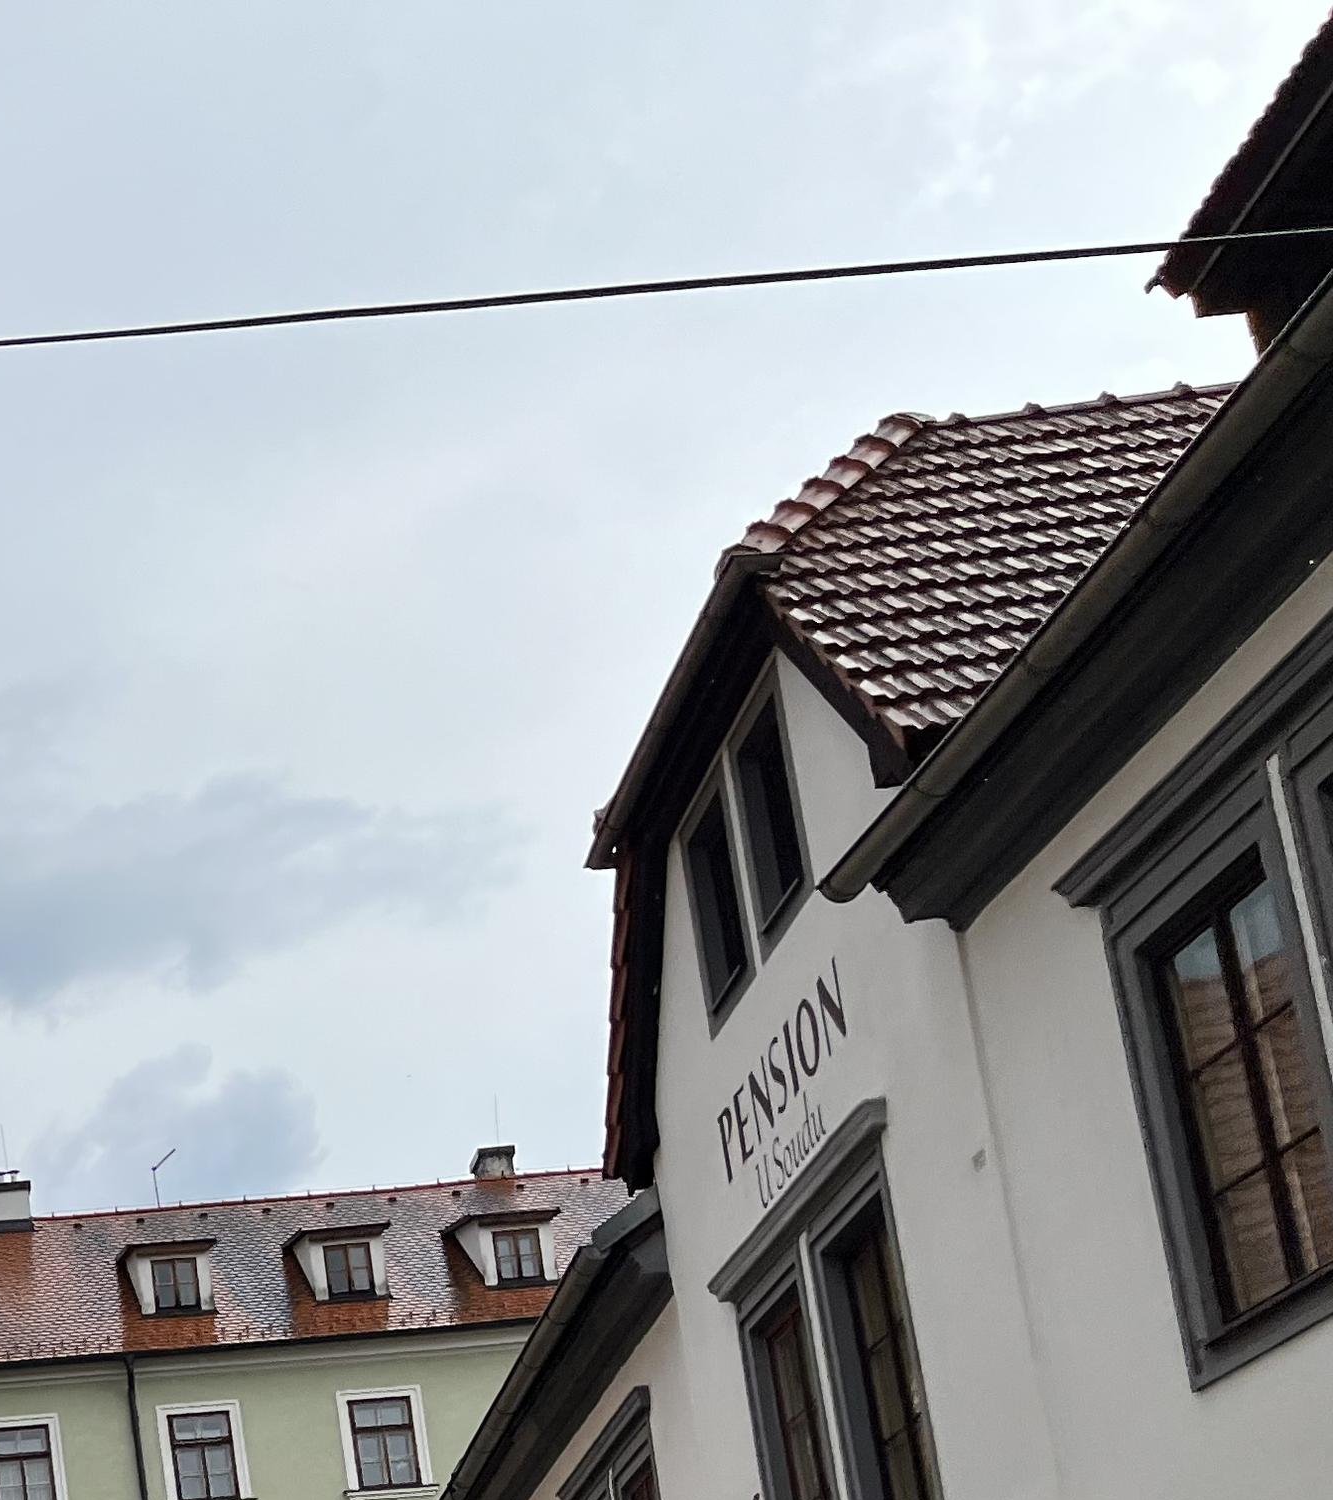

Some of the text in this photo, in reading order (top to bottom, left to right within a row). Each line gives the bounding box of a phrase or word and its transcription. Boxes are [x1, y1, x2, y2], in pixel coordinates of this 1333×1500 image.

[717, 955, 847, 1184] PENSION
[755, 1090, 827, 1209] U Soudu
